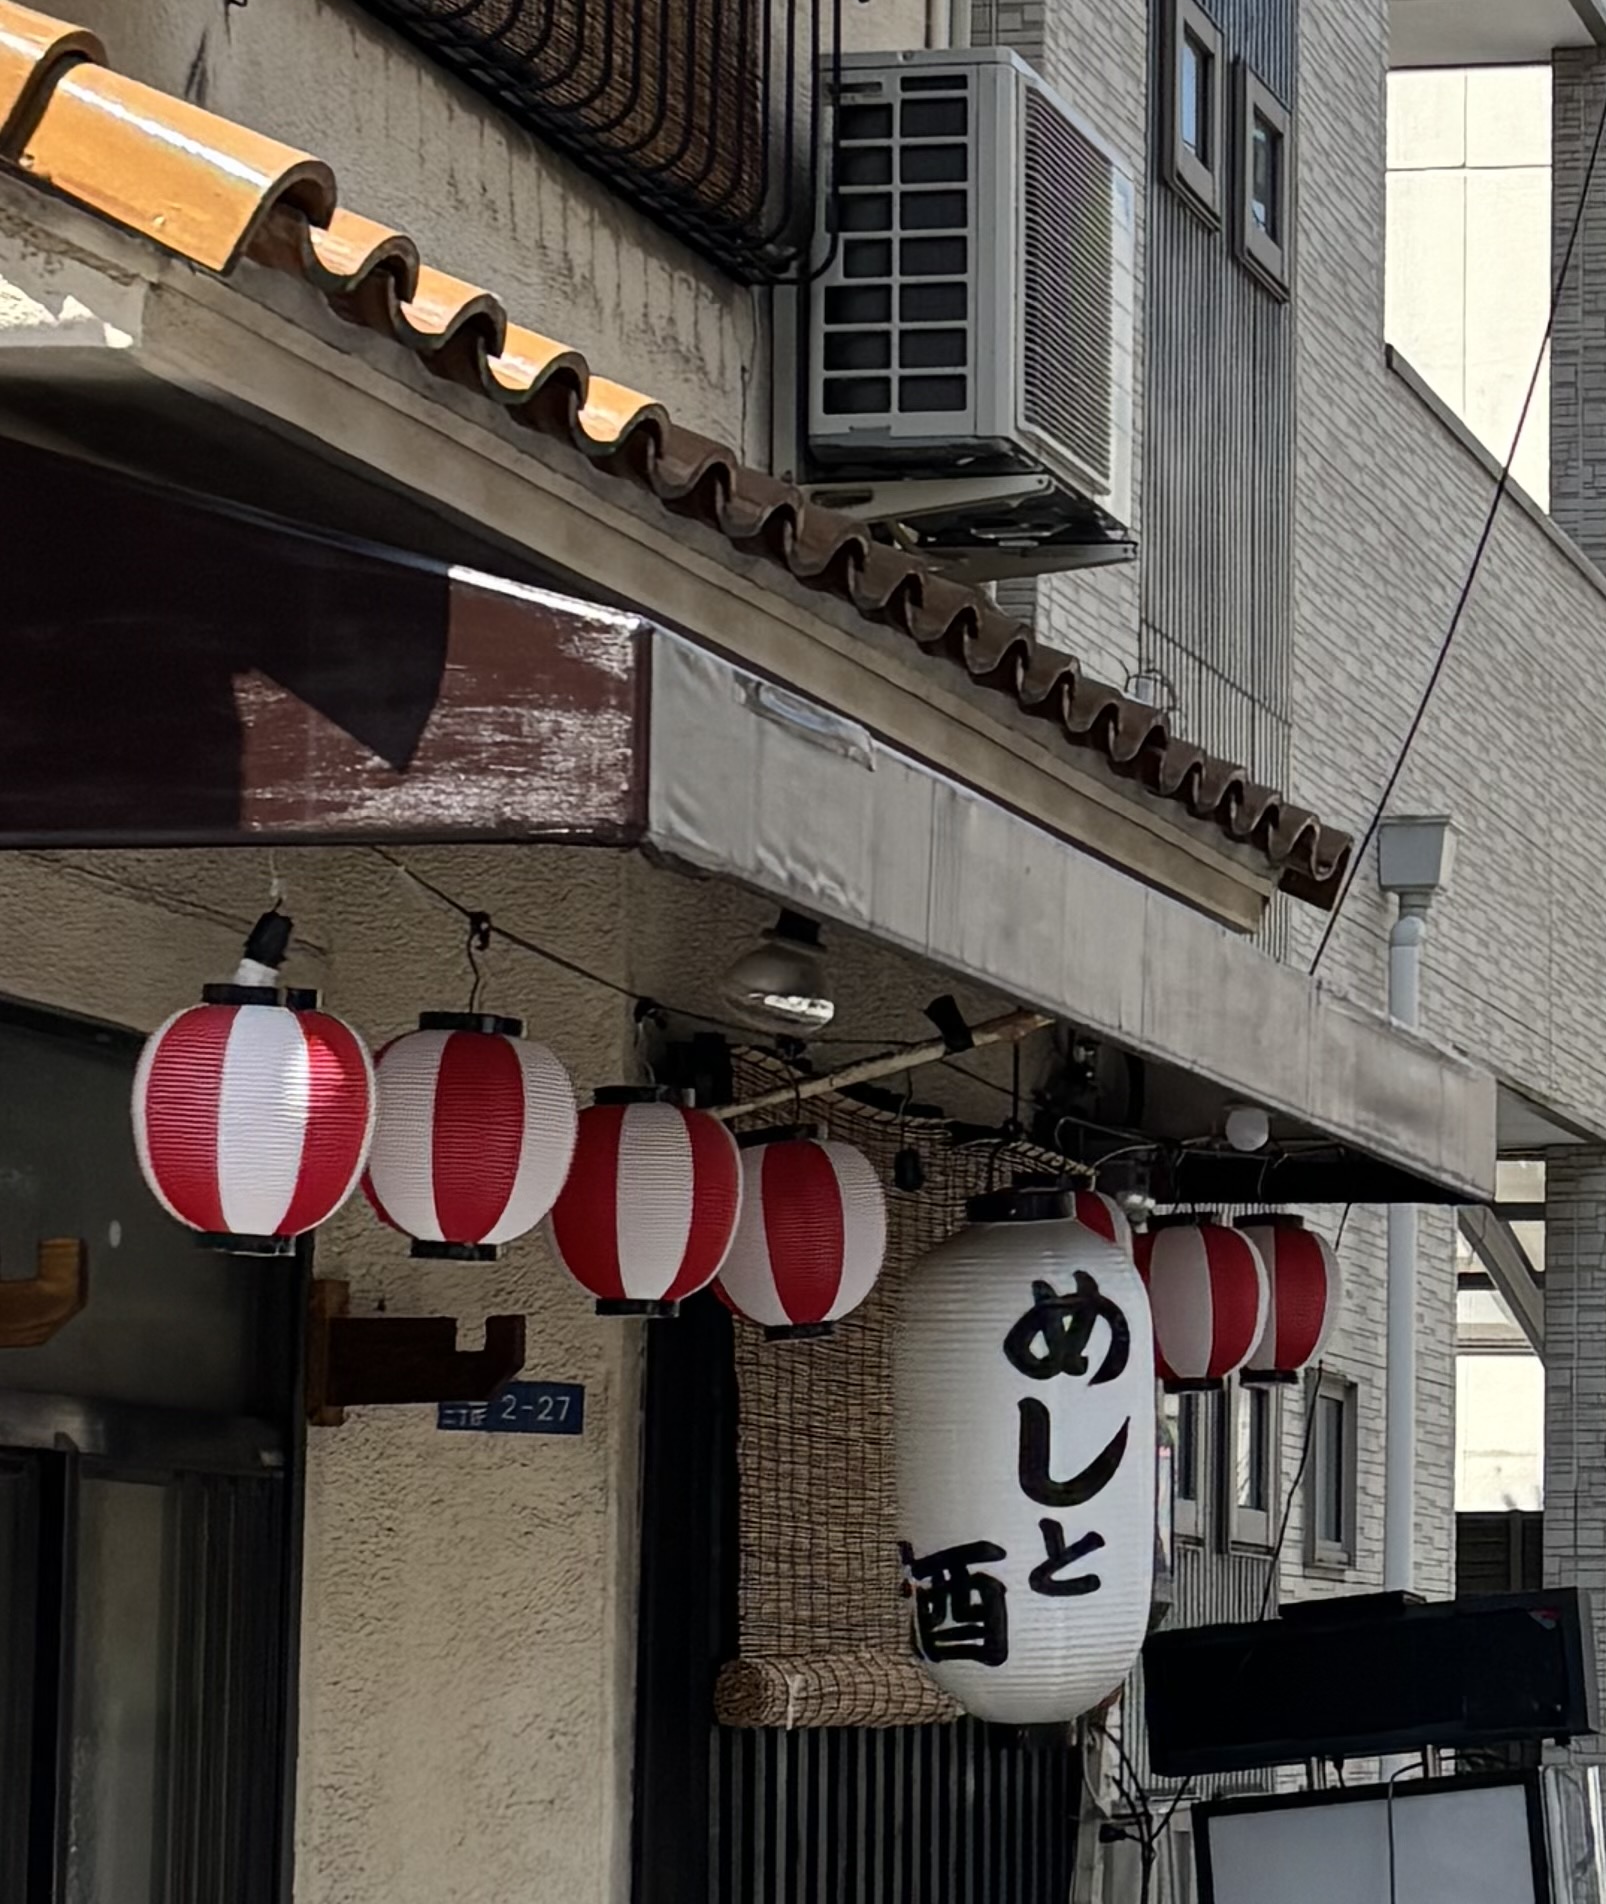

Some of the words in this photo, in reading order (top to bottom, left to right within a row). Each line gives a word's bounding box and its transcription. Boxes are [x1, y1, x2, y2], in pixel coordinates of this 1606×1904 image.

[501, 1393, 571, 1422] 2-27
[1003, 1270, 1131, 1597] めしと
